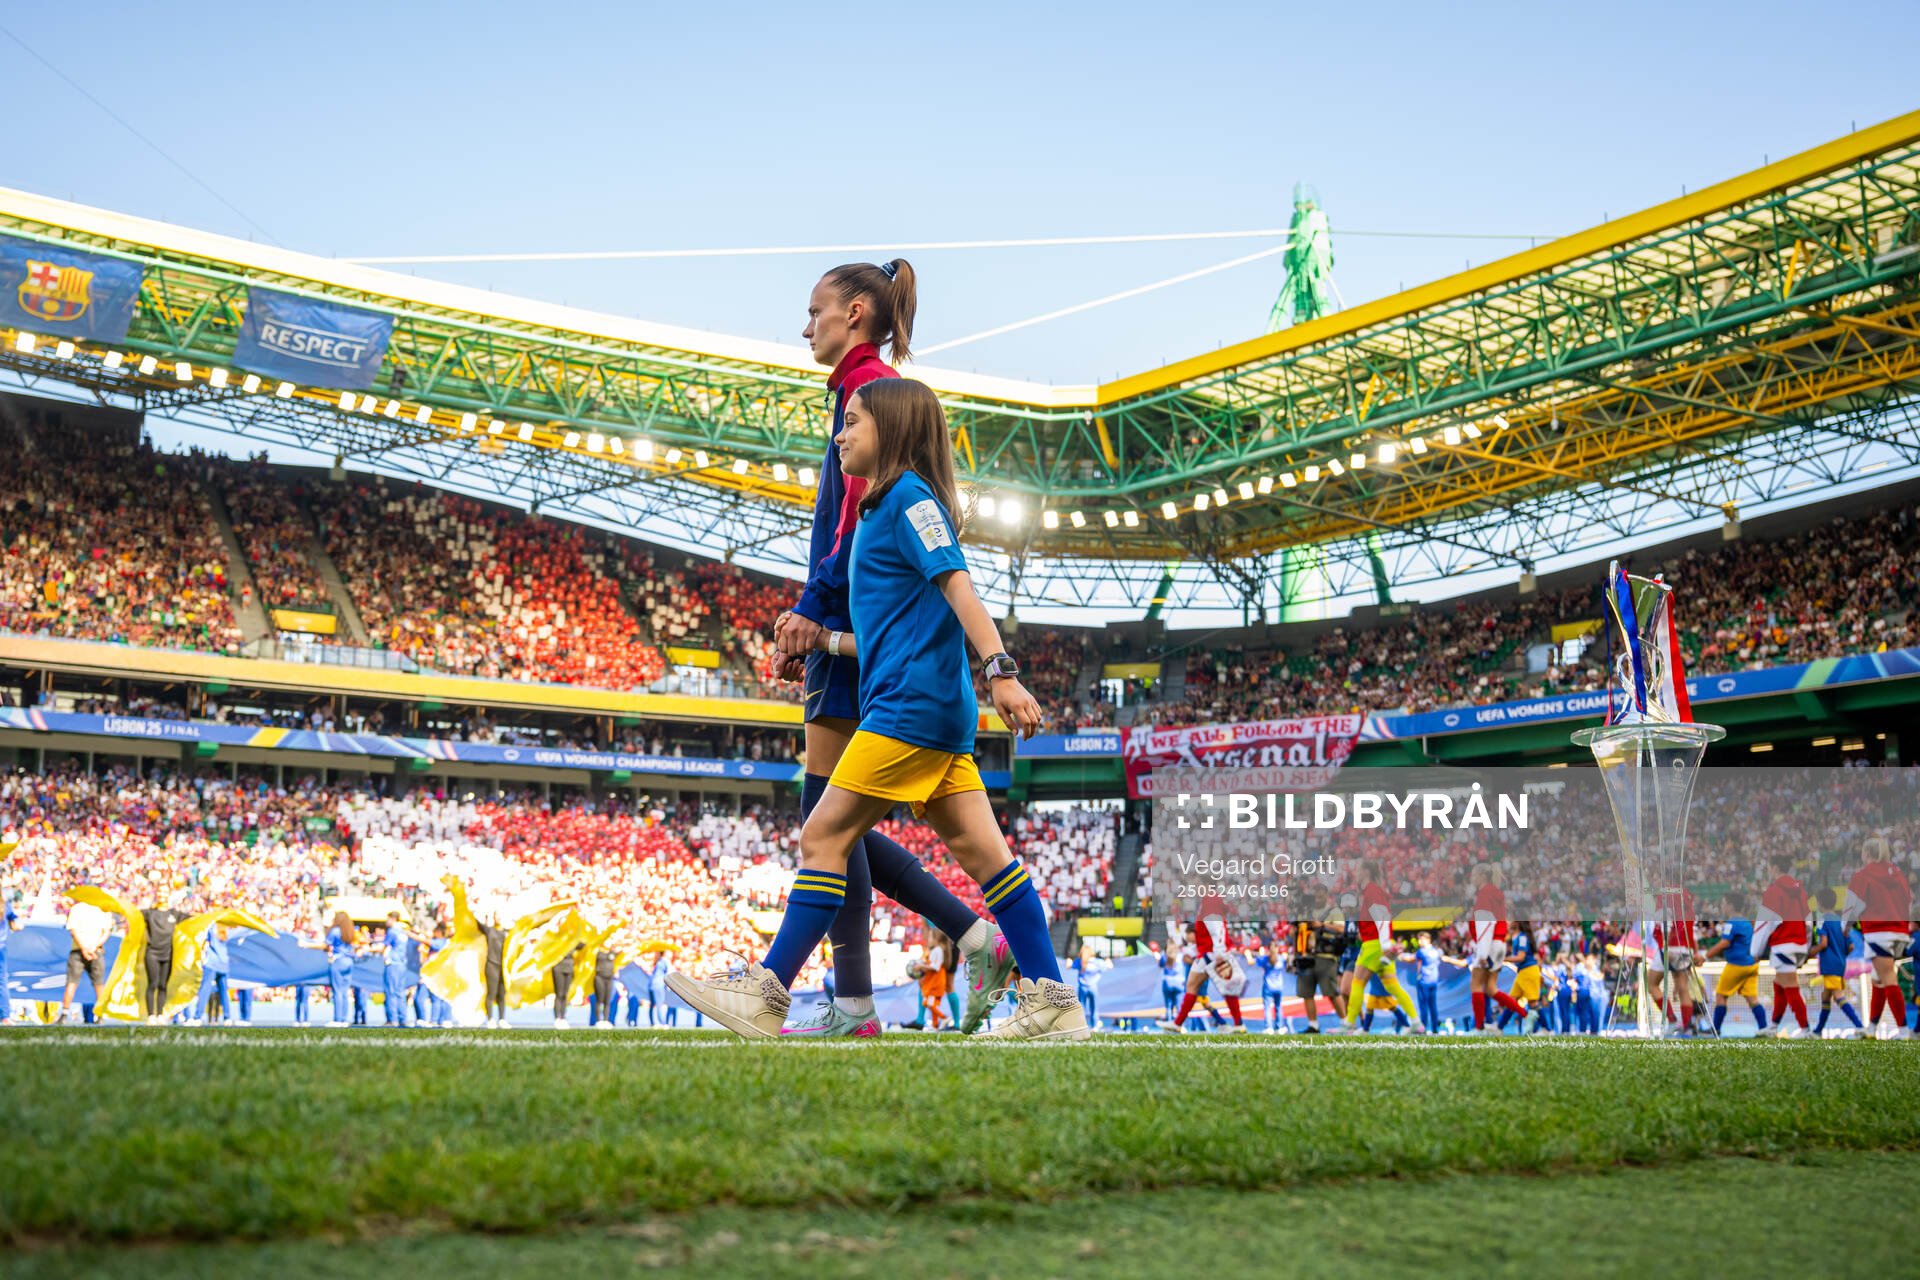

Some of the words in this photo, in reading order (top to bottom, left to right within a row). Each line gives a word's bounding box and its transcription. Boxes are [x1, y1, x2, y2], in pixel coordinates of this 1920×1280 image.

[261, 324, 365, 362] RESPECT
[104, 718, 146, 734] LISBON
[164, 724, 200, 737] FINAL
[1476, 708, 1505, 724] UEFA
[1064, 737, 1102, 752] LISBON
[1103, 736, 1118, 751] 25
[1150, 735, 1180, 748] WE
[1189, 728, 1226, 744] ALL
[1232, 721, 1305, 740] FOLLOW
[1311, 718, 1353, 734] THE
[534, 751, 563, 764] UEFA
[616, 756, 683, 772] CHAMPIONS
[684, 760, 725, 774] LEAGUE
[1141, 777, 1194, 793] OVER
[1244, 770, 1285, 787] AND
[1289, 769, 1330, 787] SEA
